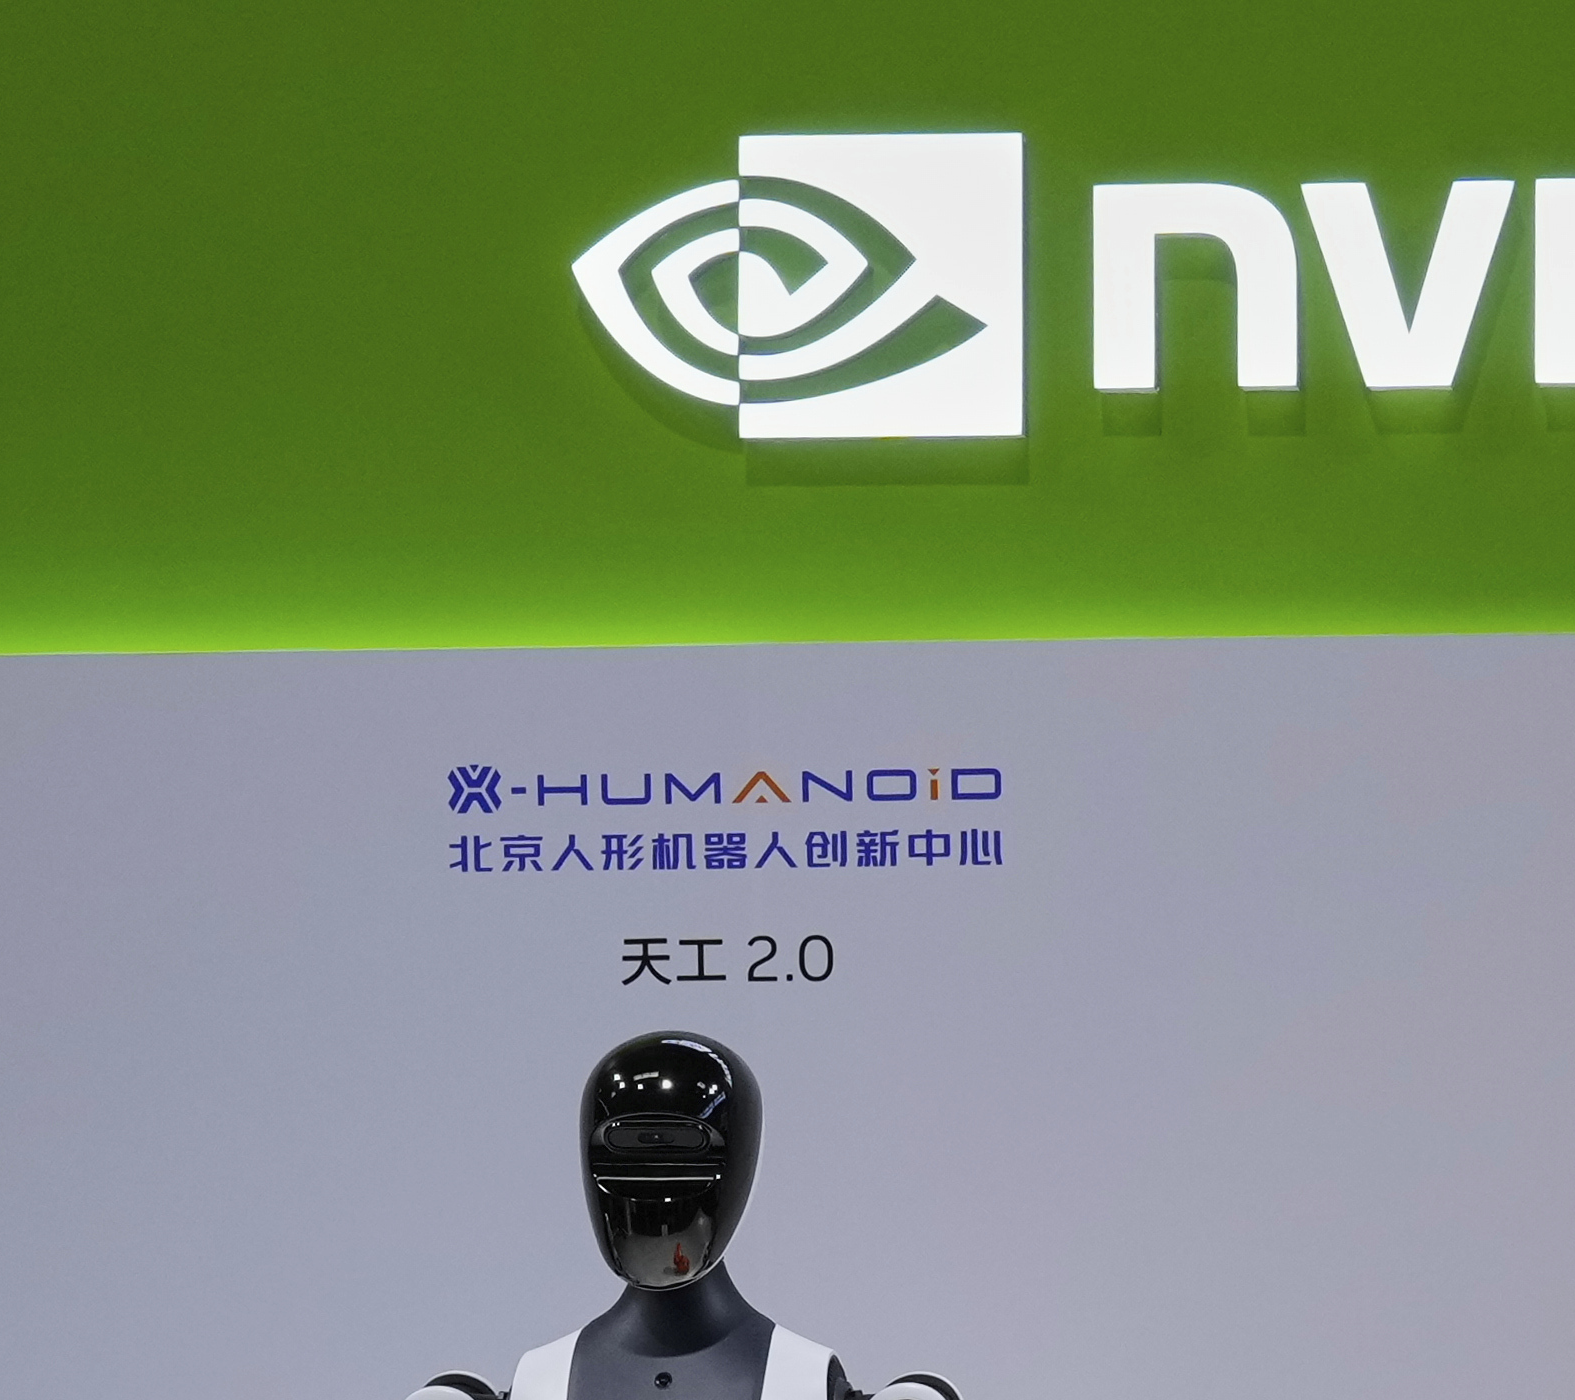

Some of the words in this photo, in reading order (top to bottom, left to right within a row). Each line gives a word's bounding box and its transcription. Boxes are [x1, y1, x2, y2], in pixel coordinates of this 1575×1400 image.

[449, 829, 1004, 874] 北京人形机器人创新中心
[622, 938, 728, 987] 天工
[748, 935, 835, 984] 2.0
